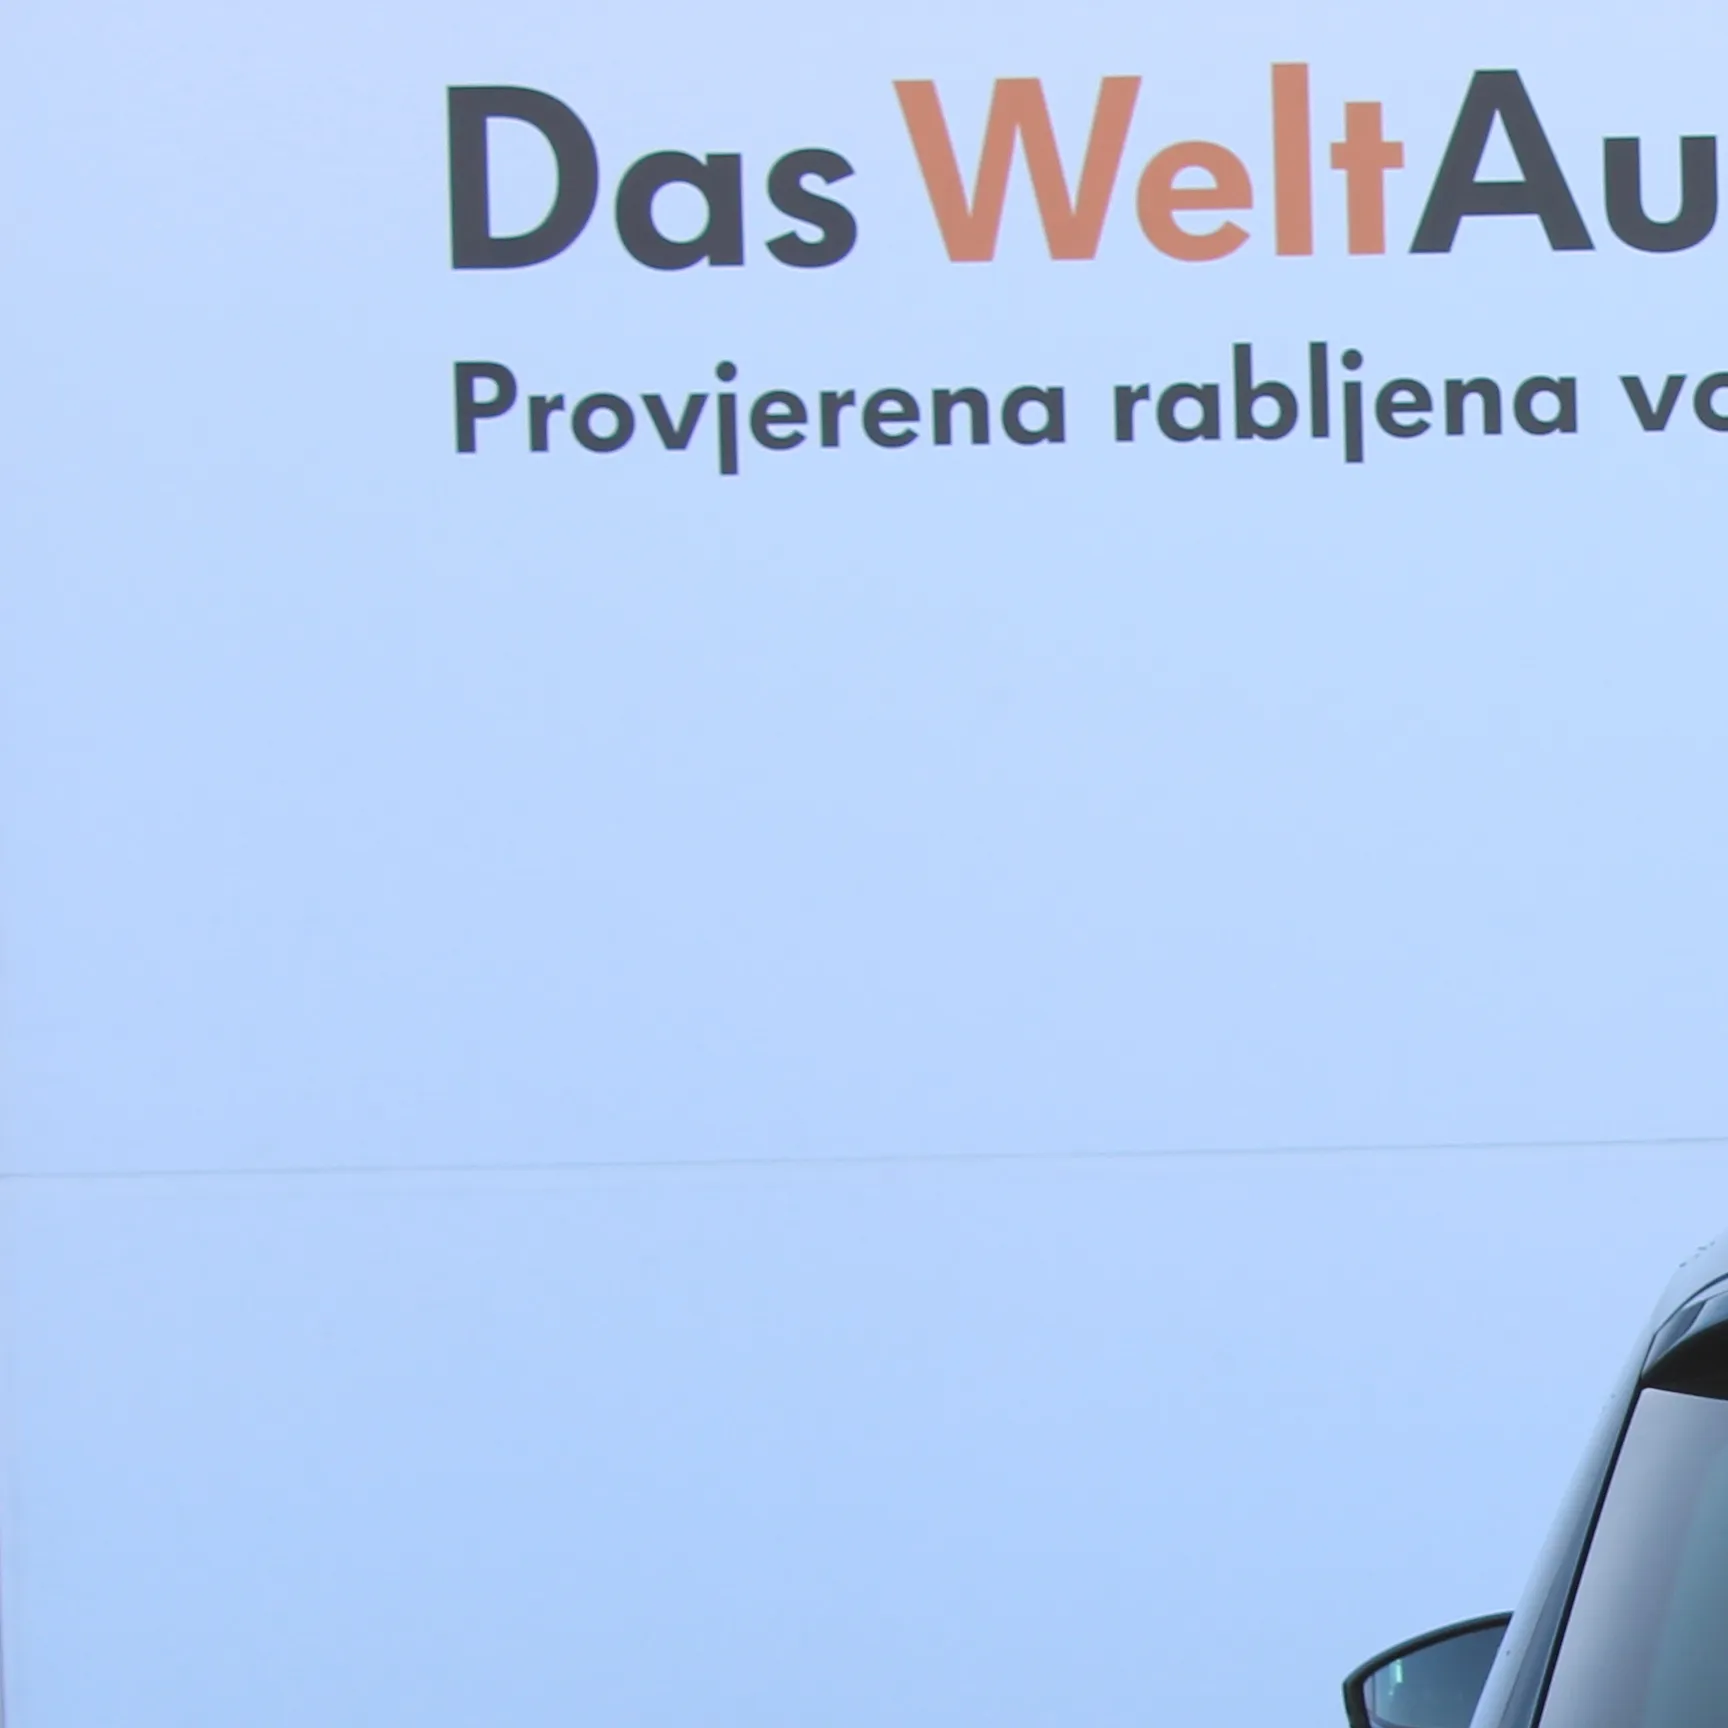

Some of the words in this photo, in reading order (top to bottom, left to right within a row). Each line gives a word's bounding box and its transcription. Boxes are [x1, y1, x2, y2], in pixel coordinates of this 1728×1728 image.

[446, 84, 858, 272] Das
[453, 360, 1066, 476] Provjerena
[1114, 341, 1578, 464] rabljena
